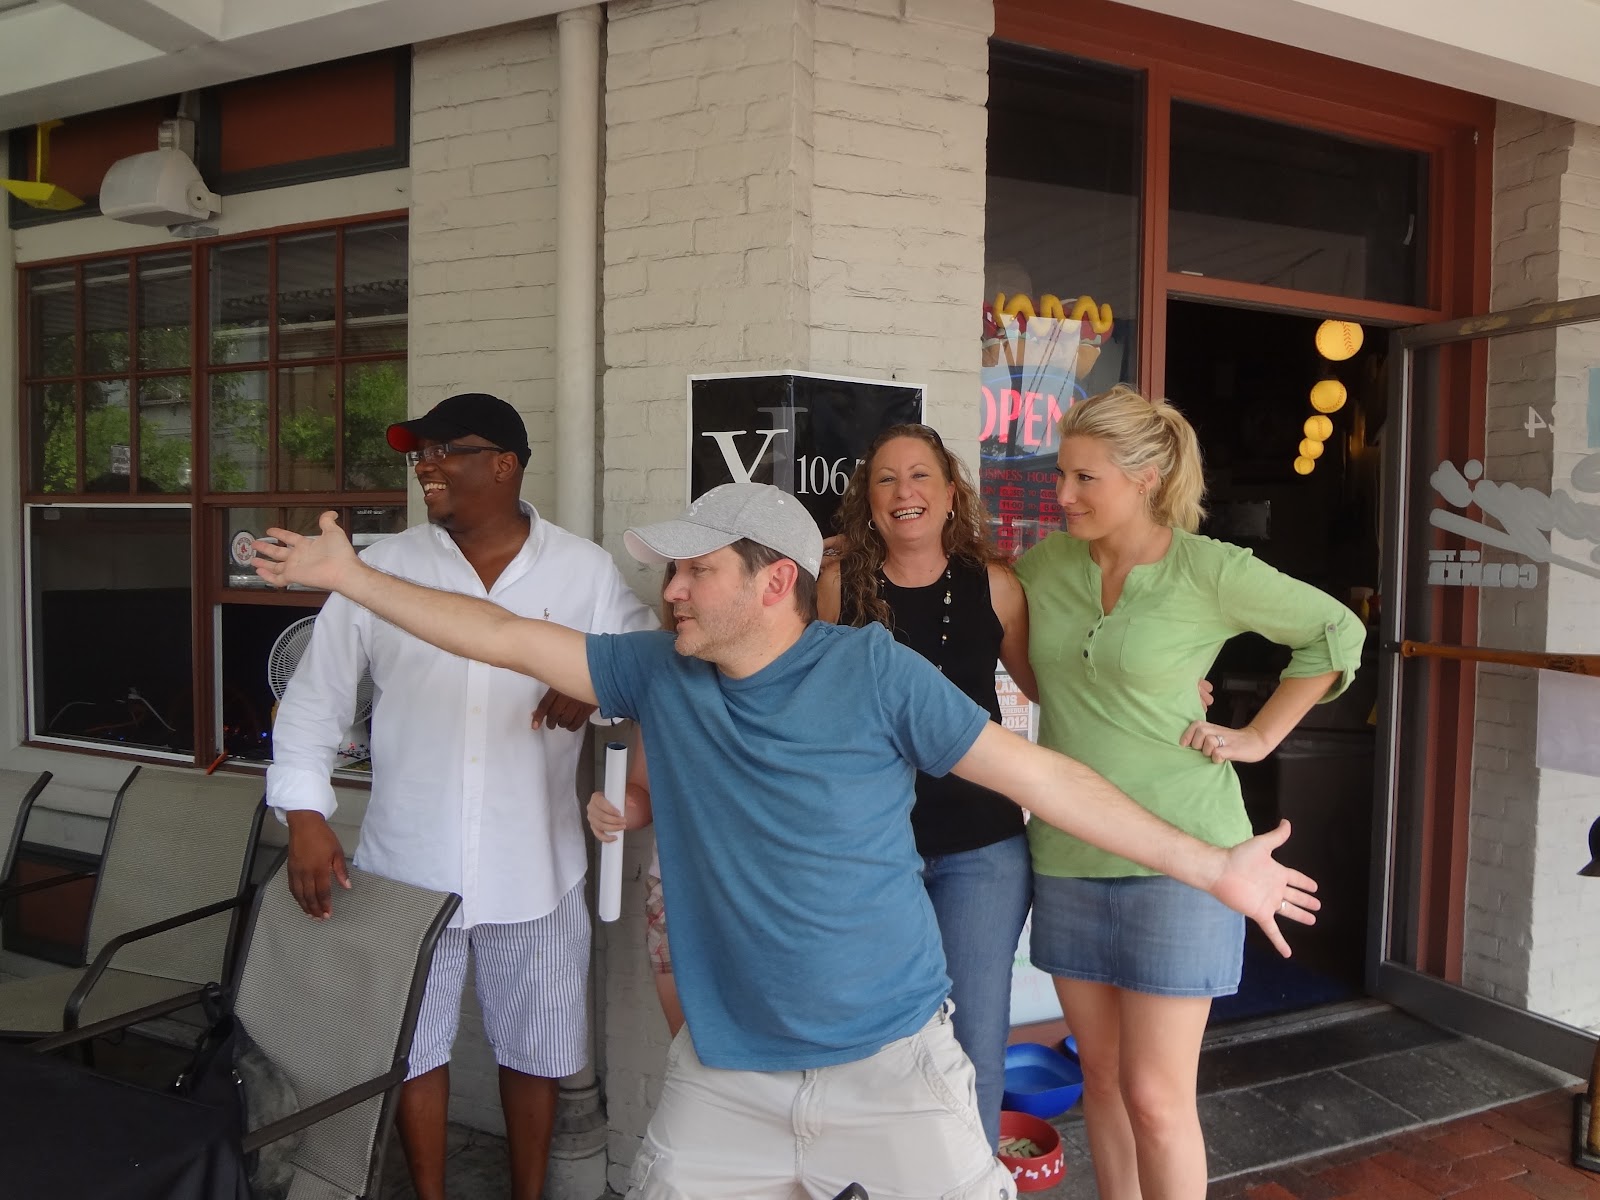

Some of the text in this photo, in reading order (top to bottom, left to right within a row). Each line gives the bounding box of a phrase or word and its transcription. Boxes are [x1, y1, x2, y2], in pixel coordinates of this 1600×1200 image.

[979, 385, 1075, 447] OPEN
[980, 468, 1059, 483] USINESS HOUR
[1001, 716, 1028, 729] 2012
